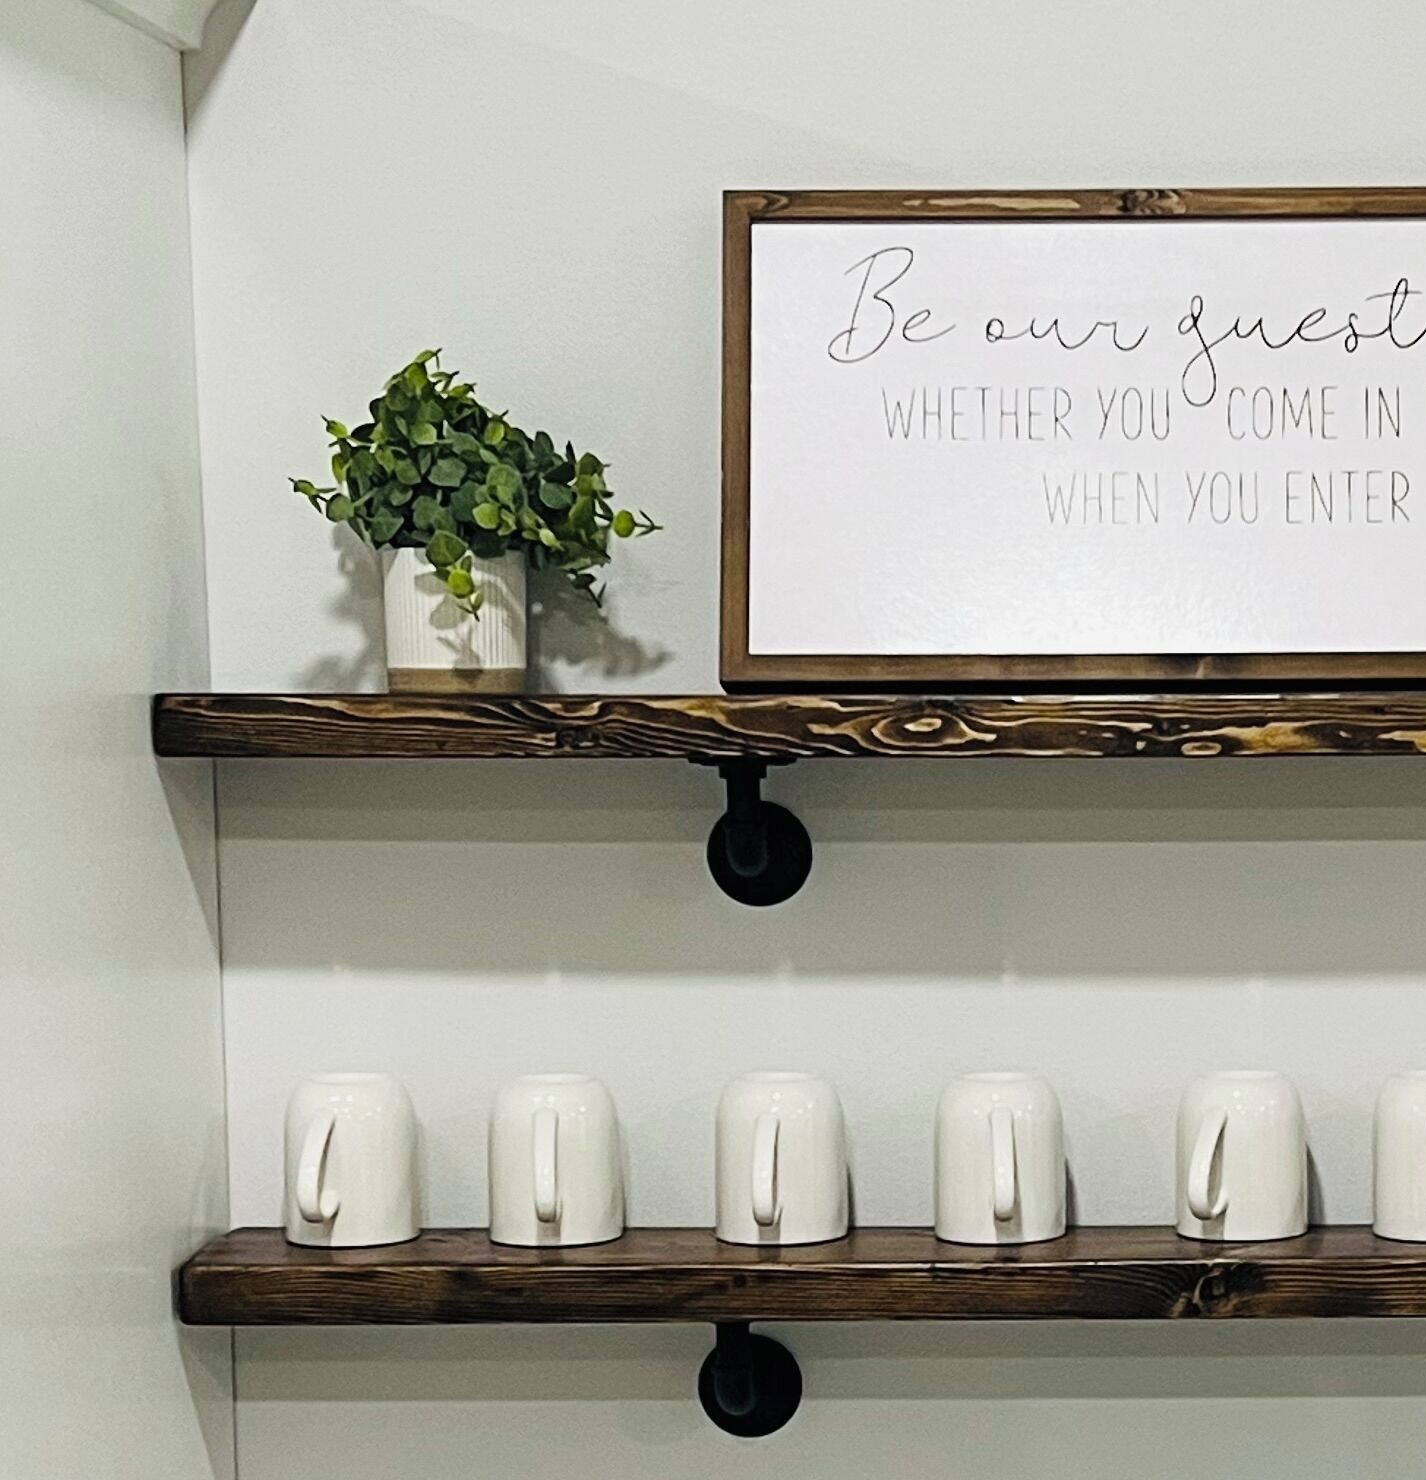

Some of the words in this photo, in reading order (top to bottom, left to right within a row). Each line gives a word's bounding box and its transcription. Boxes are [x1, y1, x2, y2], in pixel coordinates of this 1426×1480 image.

[827, 245, 957, 363] Be
[985, 316, 1150, 353] our
[881, 386, 1073, 442] WHETHER
[1096, 386, 1171, 442] YOU
[1227, 385, 1339, 441] COME
[1364, 385, 1401, 440] IN
[1042, 471, 1159, 526] WHEN
[1185, 470, 1259, 525] YOU
[1285, 469, 1411, 525] ENTER
